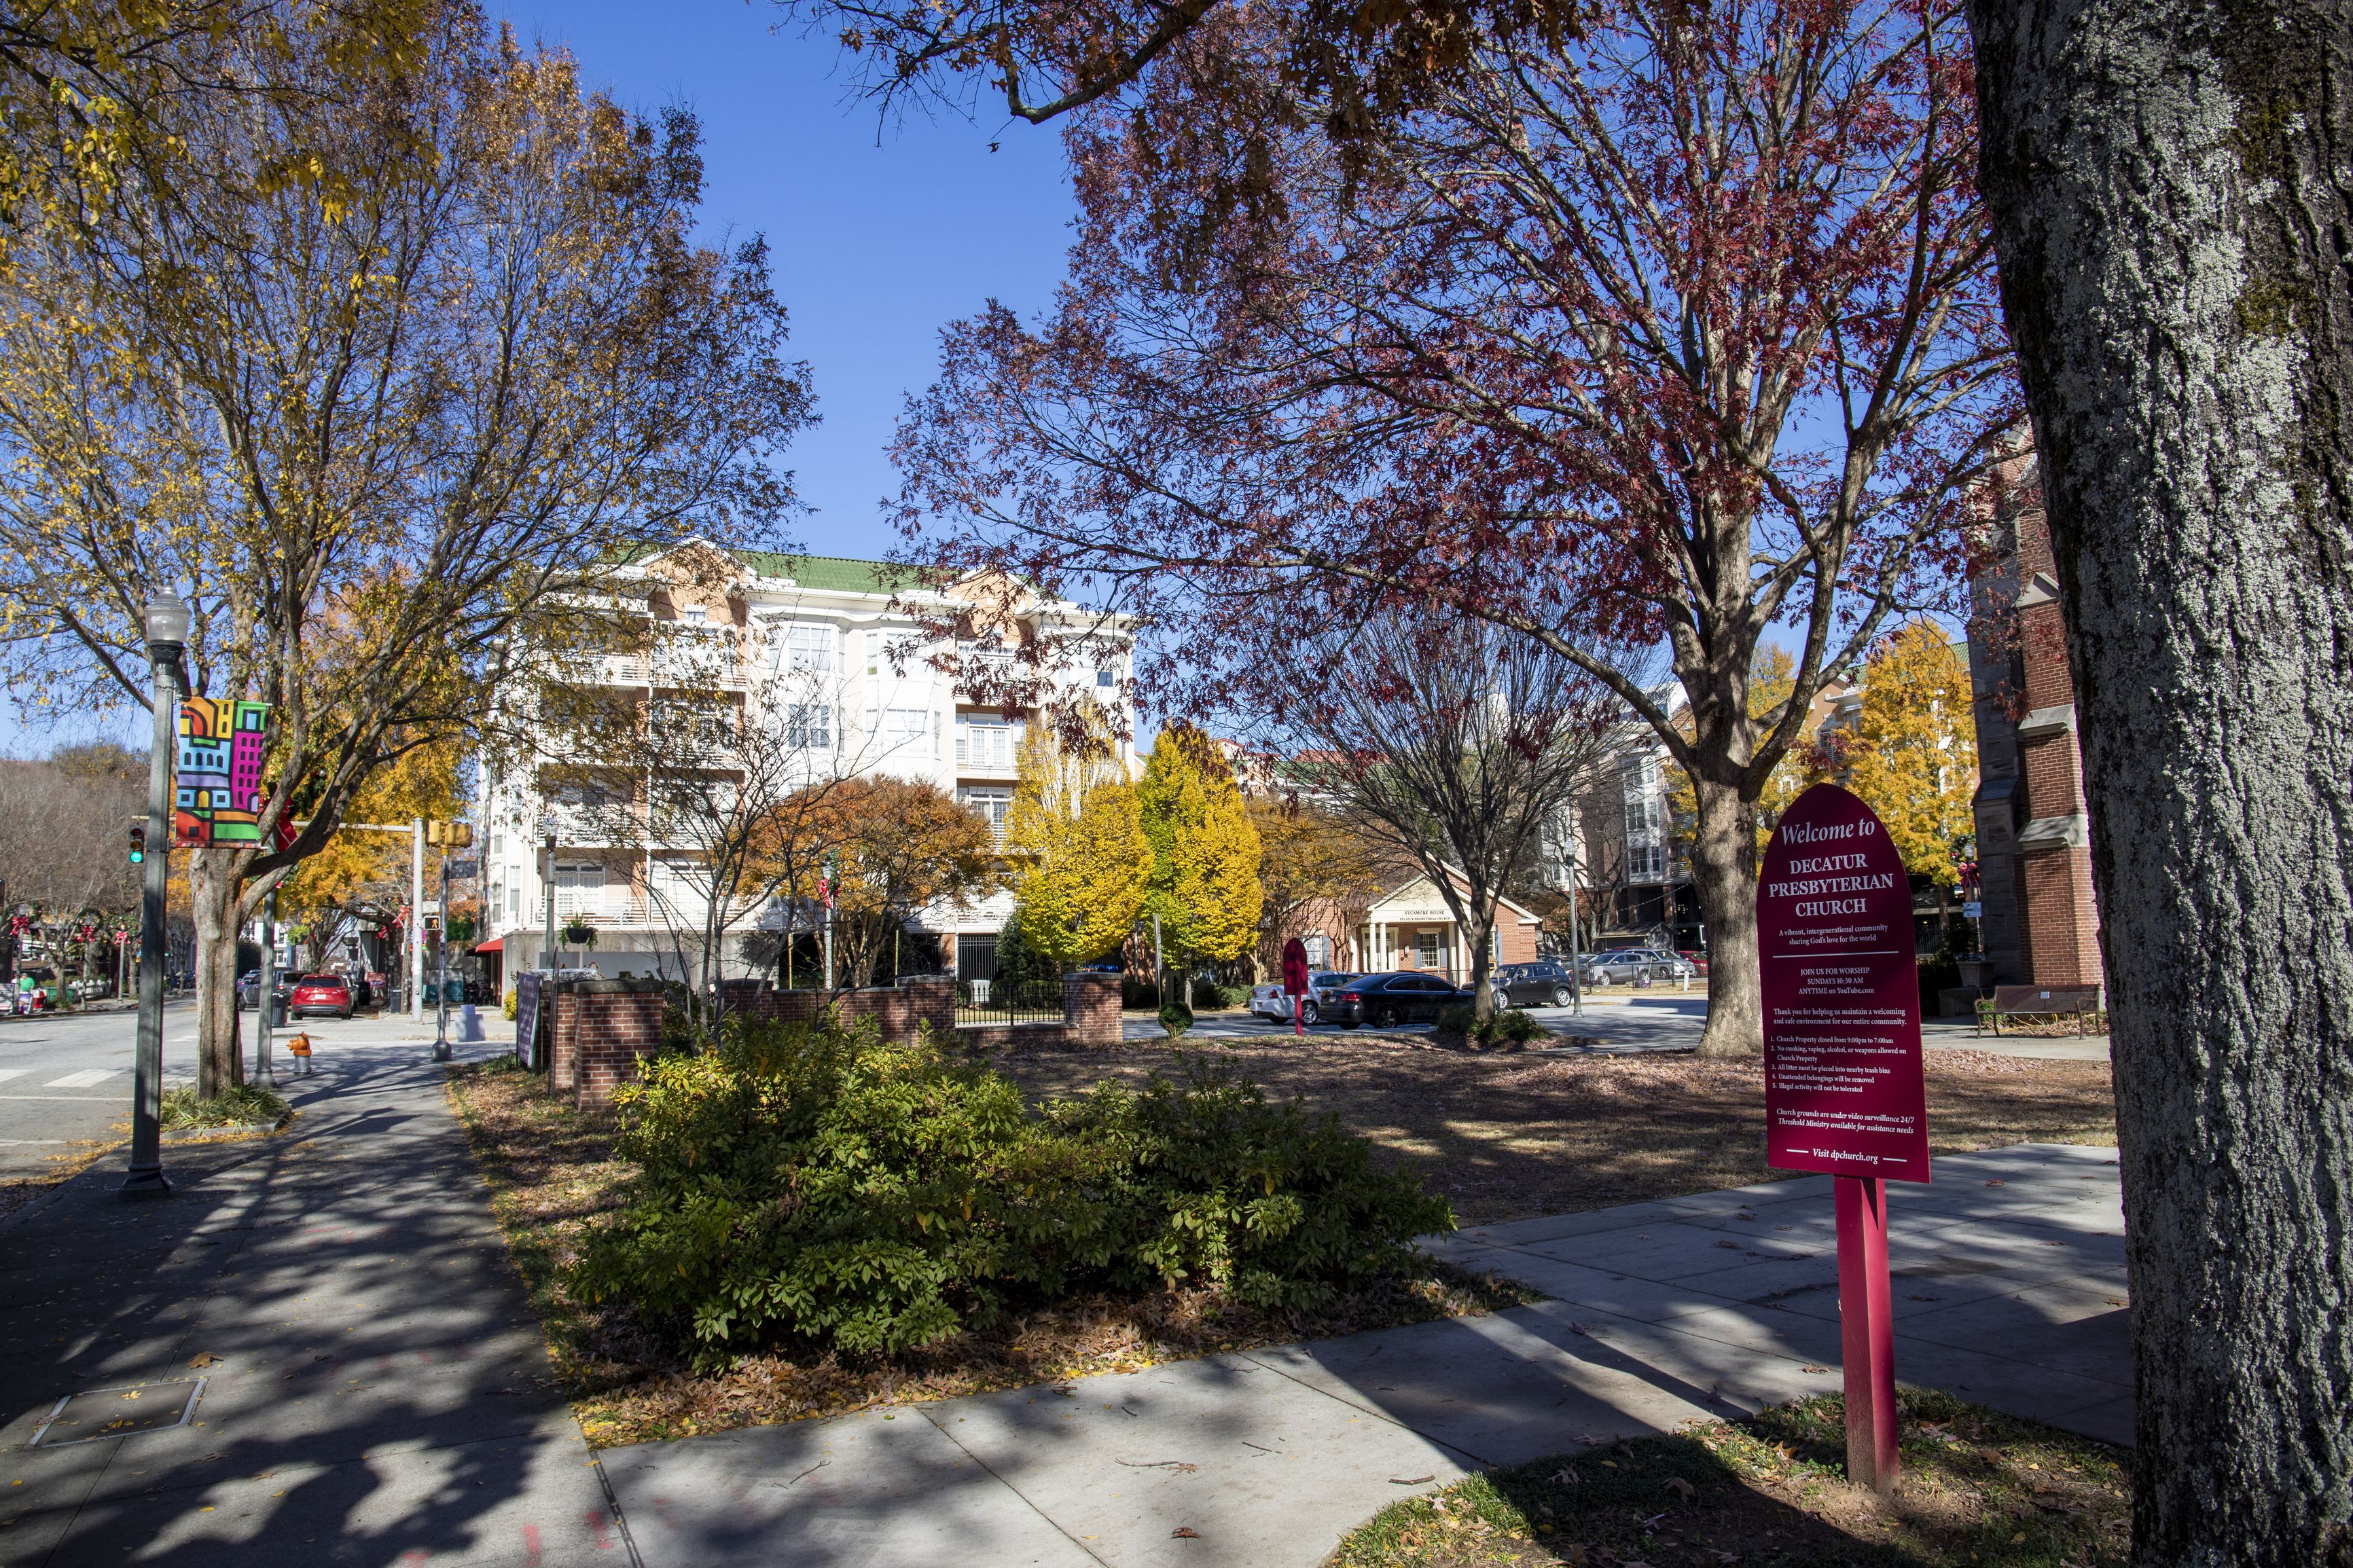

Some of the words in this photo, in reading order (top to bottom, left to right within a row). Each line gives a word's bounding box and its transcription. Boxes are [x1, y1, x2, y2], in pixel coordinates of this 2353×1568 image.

[1781, 822, 1854, 845] Welcome
[1858, 818, 1875, 835] to
[1789, 854, 1868, 874] DECATUR
[1769, 873, 1893, 897] PRESBYTERIAN
[1795, 898, 1867, 917] CHURCH
[1807, 926, 1853, 935] intergenerational
[1812, 1008, 1833, 1016] helping
[1873, 1008, 1905, 1016] welcoming
[1807, 1074, 1833, 1082] belongings
[1778, 1118, 1805, 1126] Threshold
[1806, 1120, 1829, 1129] Ministry
[1856, 1124, 1865, 1132] for
[1865, 1114, 1899, 1123] surveillance
[1813, 1148, 1829, 1158] Visit
[1831, 1151, 1878, 1165] dpchurch.org
